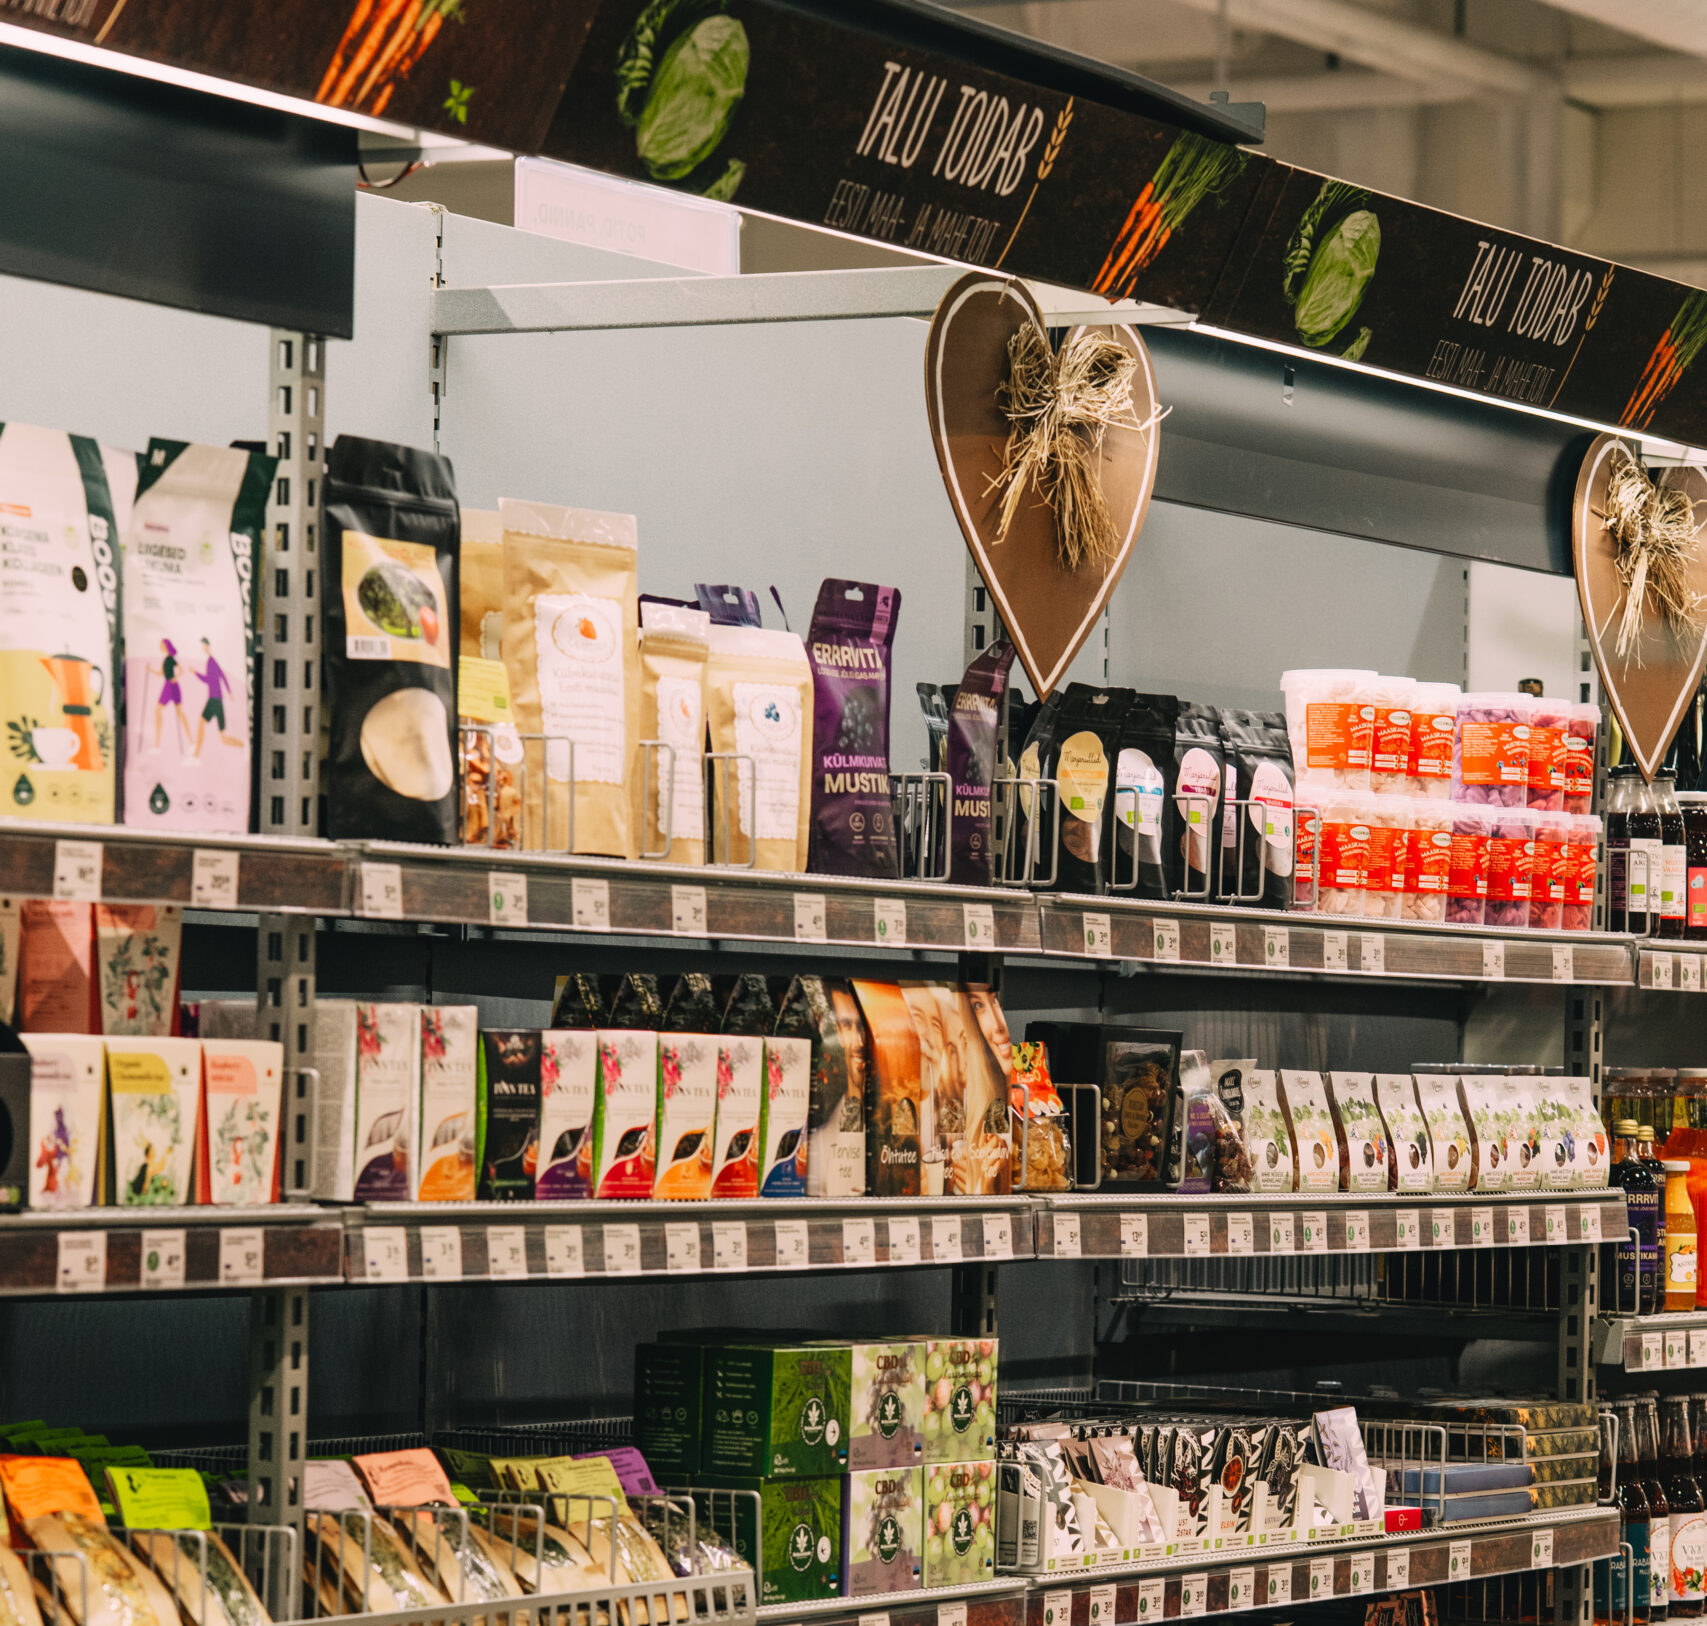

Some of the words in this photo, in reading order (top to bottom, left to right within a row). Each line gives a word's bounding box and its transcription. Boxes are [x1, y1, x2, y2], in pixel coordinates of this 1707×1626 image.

[856, 61, 948, 168] TALU
[932, 85, 1044, 197] TOIDAB
[824, 178, 870, 230] EESTI
[904, 203, 932, 246] JA
[1453, 241, 1523, 327] TALU
[1507, 257, 1593, 346] TOIDAB
[1426, 339, 1462, 381] EESTI
[1483, 355, 1506, 393] JA
[518, 1083, 536, 1096] TEA
[876, 1355, 899, 1370] CBD
[949, 1350, 971, 1365] CBD
[874, 1479, 897, 1495] CBD
[950, 1473, 970, 1489] CBD
[1178, 1518, 1188, 1527] UST
